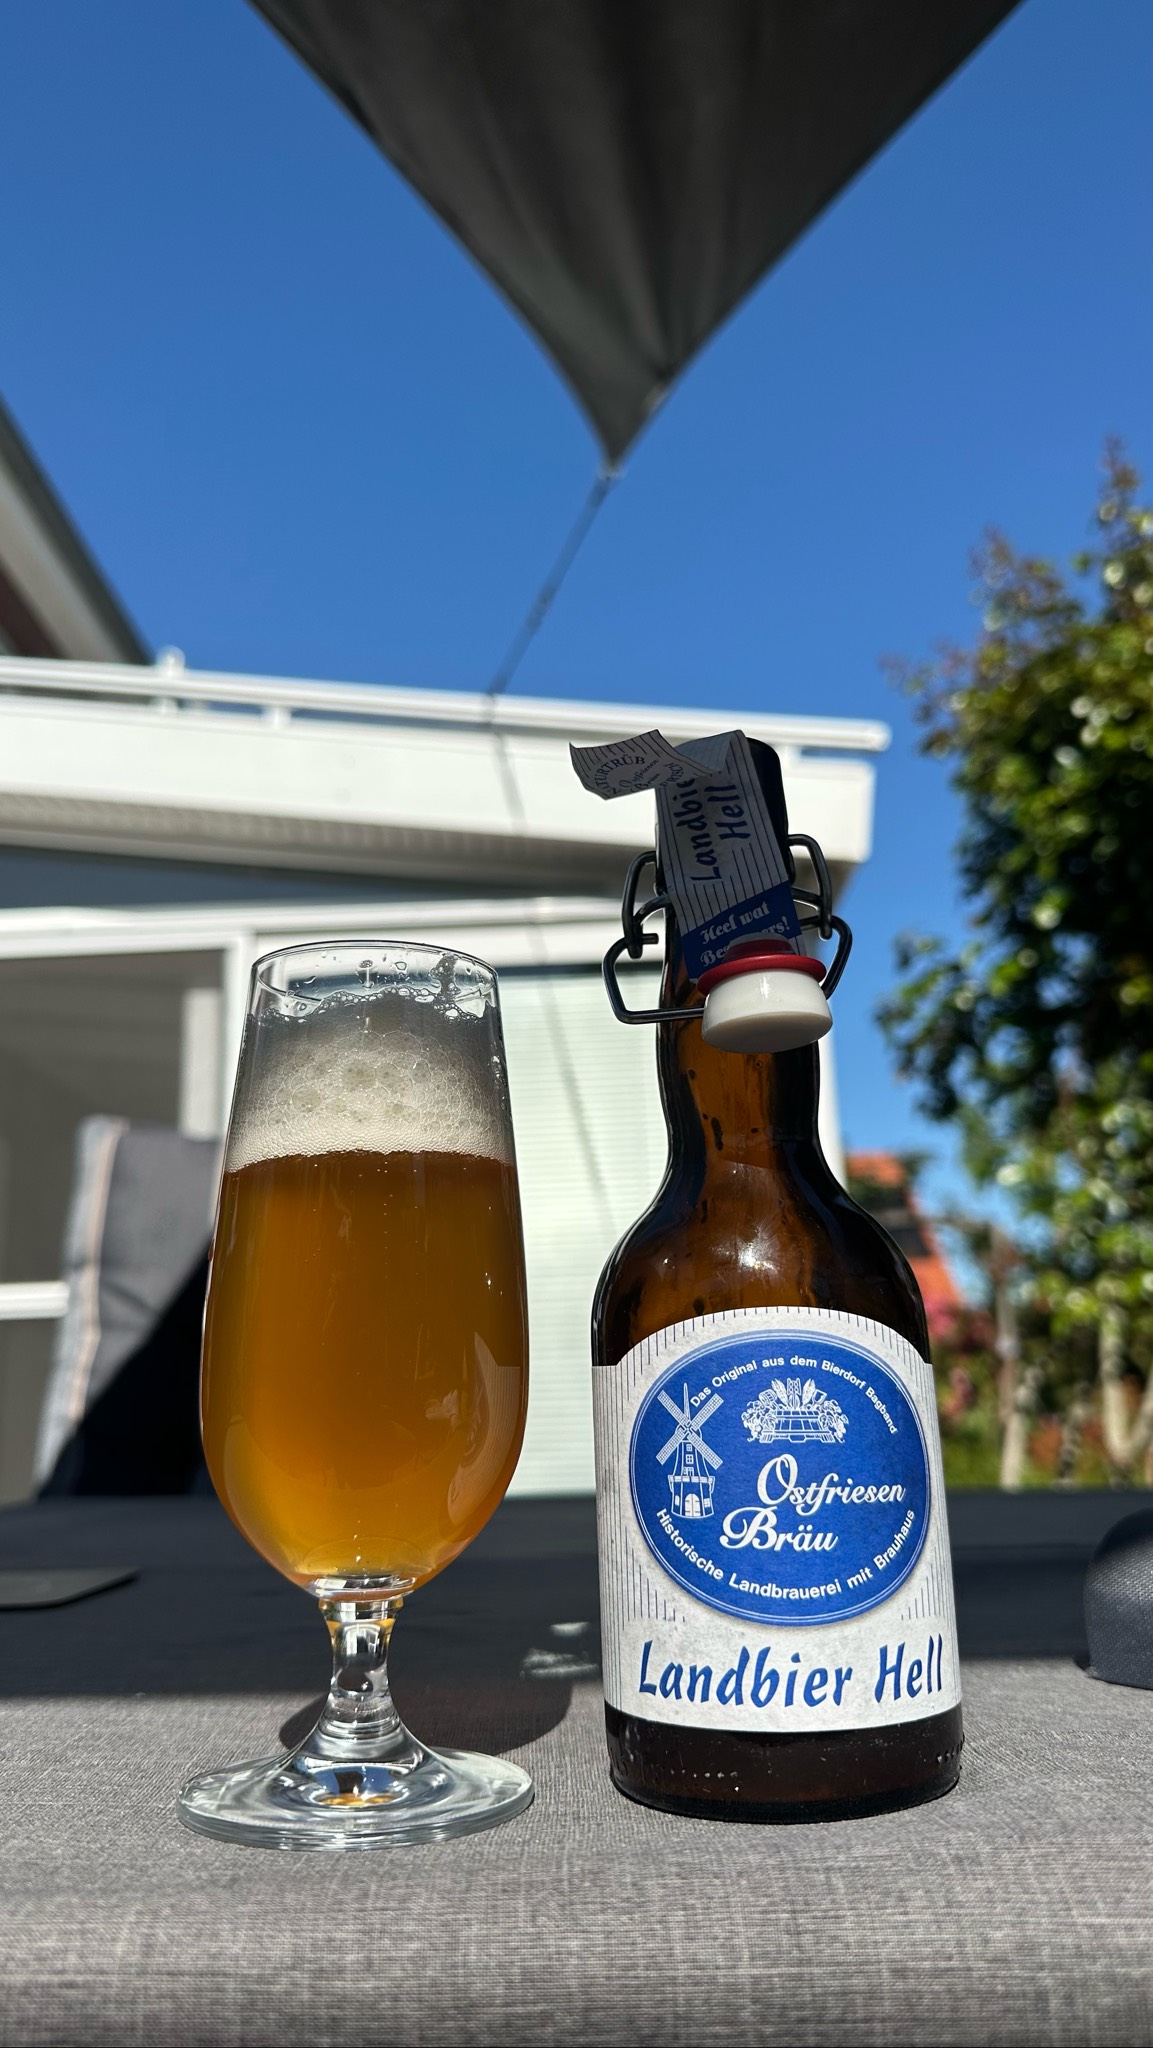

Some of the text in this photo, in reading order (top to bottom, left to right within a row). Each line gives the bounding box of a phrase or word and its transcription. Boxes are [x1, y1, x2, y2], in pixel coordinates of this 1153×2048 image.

[673, 778, 722, 881] Landbie
[704, 784, 751, 840] Hell
[700, 901, 770, 944] Heel wat
[690, 1355, 898, 1434] Das Original aus dem Bierdorf Bagband
[756, 1453, 906, 1516] Ostfriesen
[656, 1508, 916, 1600] Historische Landbrauerei mit Brauhaus
[719, 1505, 840, 1552] Bräu
[638, 1632, 944, 1709] Landbier Hell
